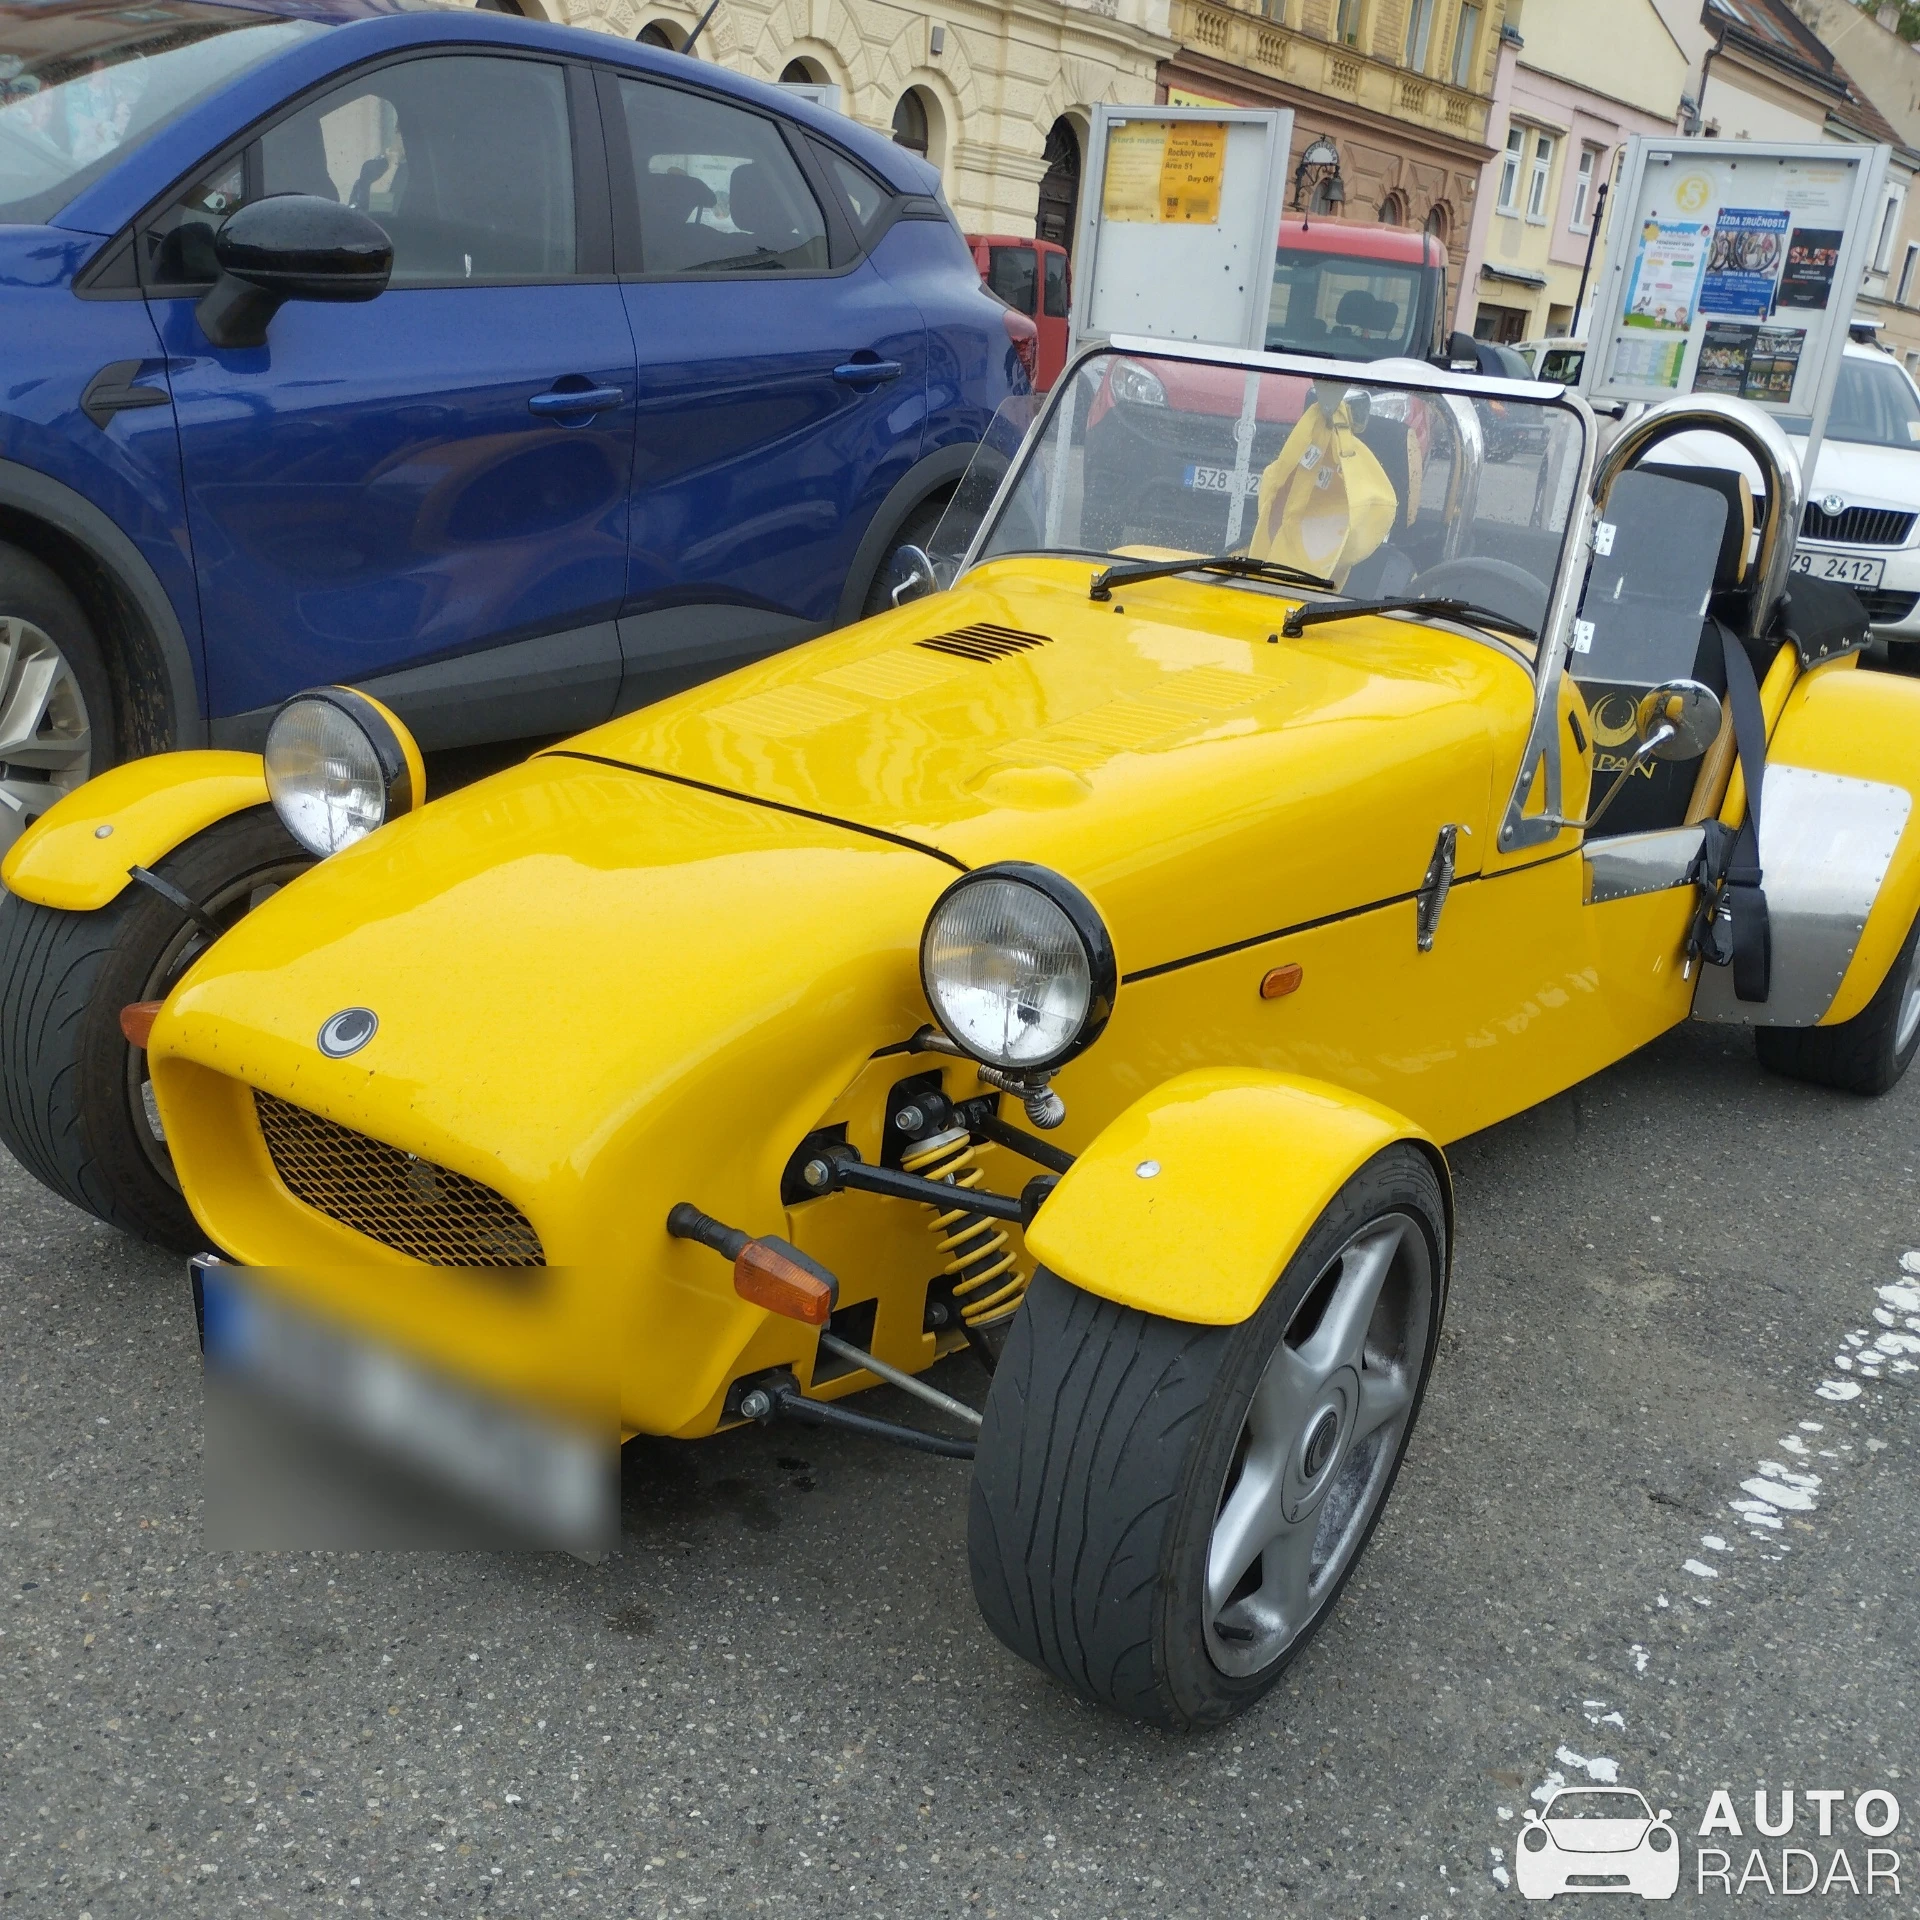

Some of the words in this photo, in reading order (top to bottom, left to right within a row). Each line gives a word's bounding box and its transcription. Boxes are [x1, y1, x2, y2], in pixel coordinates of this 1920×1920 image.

[1168, 147, 1195, 159] Rockový
[1197, 150, 1216, 158] večer
[1165, 161, 1182, 170] Area
[1187, 175, 1201, 184] Day
[1203, 175, 1215, 183] Off
[1717, 214, 1740, 226] JÍZDA
[1741, 215, 1787, 228] ZRUČNOSTI
[1197, 469, 1227, 489] 5Z8
[1824, 558, 1873, 581] 2412
